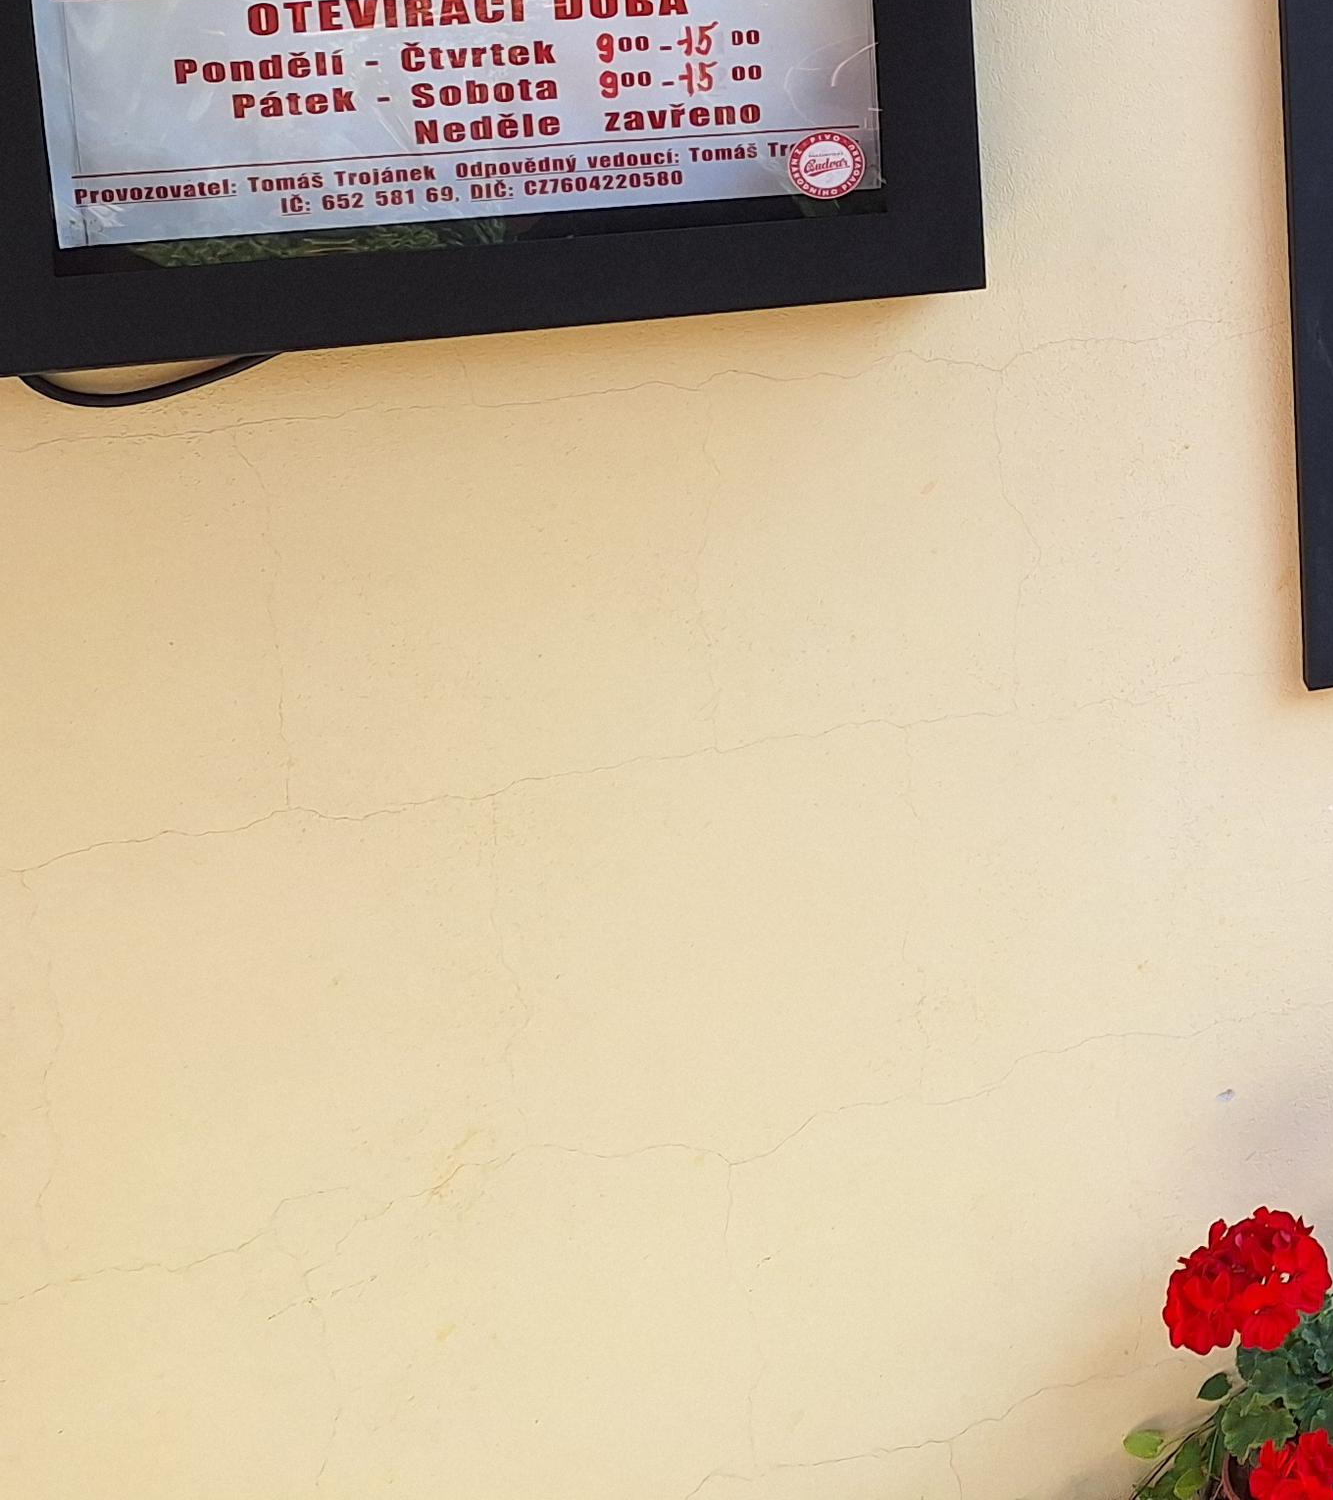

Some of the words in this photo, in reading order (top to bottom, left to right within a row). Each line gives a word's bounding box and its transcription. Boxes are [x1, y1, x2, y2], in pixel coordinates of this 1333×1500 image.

[174, 49, 343, 84] Pondělí
[401, 41, 556, 72] Čtvrtek
[232, 88, 356, 119] Pátek
[411, 79, 558, 108] Sobota
[415, 113, 560, 145] Neděle
[604, 102, 761, 132] zavřeno
[74, 179, 237, 205] Provozovatel:
[247, 172, 324, 193] Tomáš
[334, 166, 436, 186] Trojánek
[456, 155, 576, 178] Odpovědný
[587, 149, 680, 169] vedoucí:
[689, 142, 758, 163] Tomáš
[281, 194, 311, 213] IČ:
[322, 193, 364, 211] 652
[375, 188, 415, 206] 581
[471, 180, 513, 200] DIČ:
[524, 170, 683, 195] CZ7604220580
